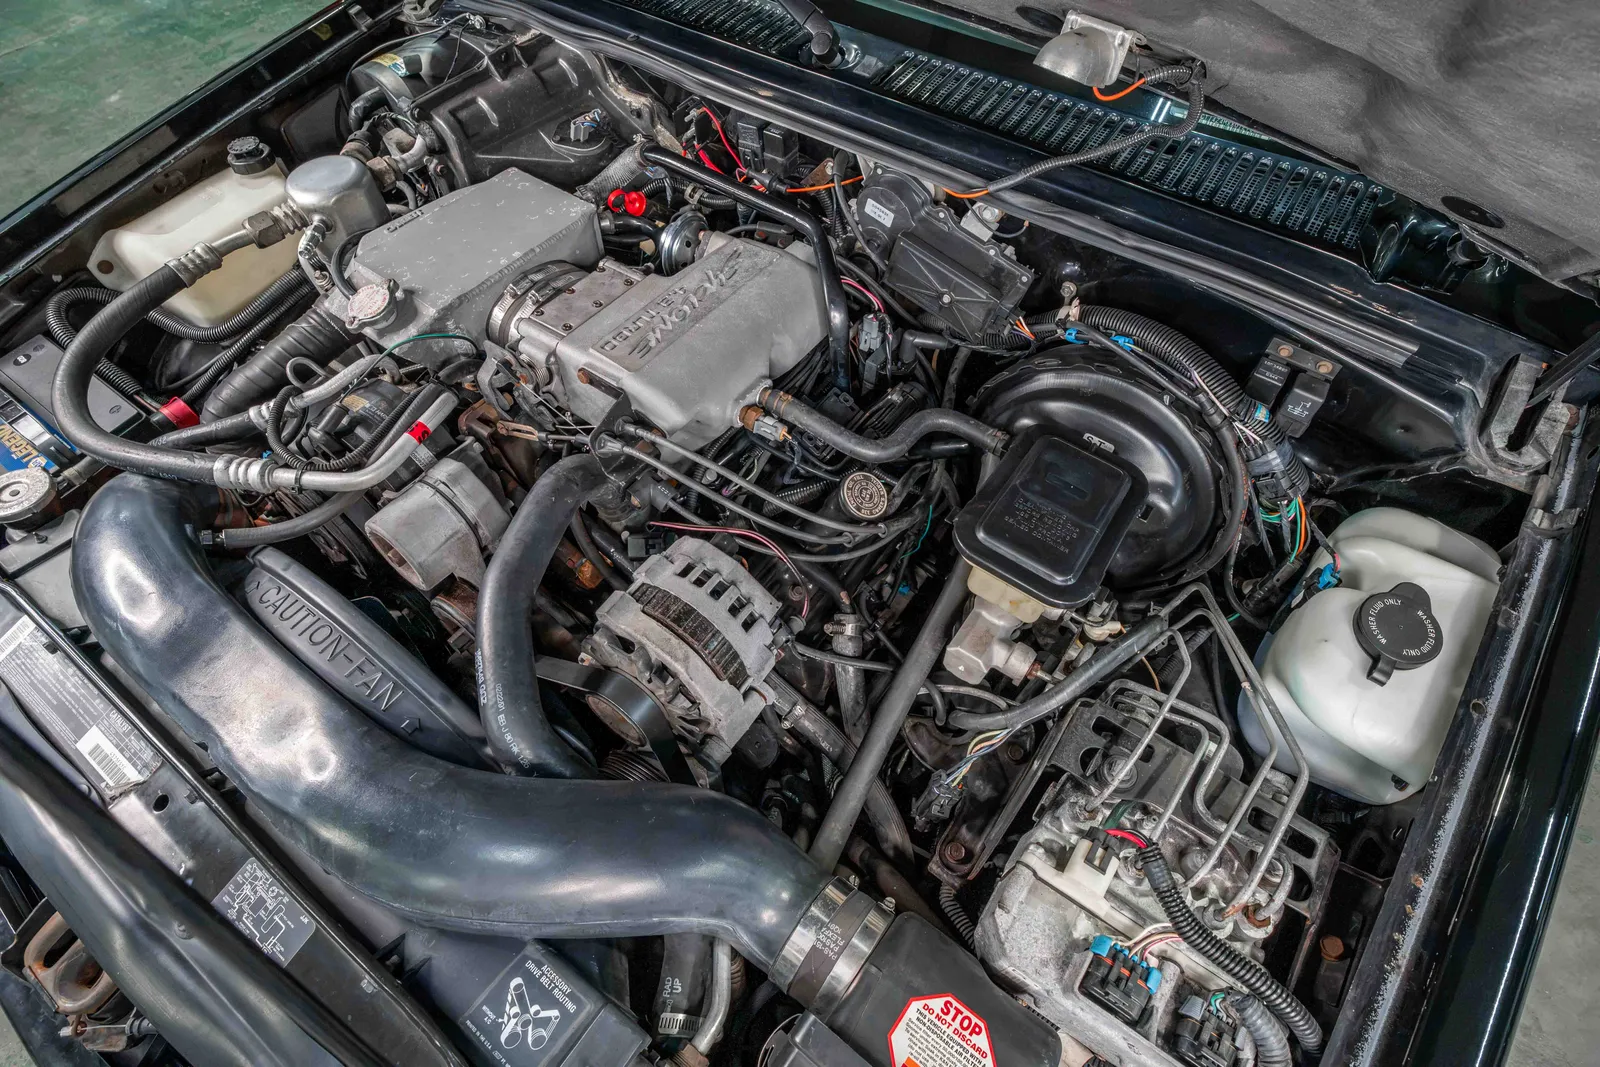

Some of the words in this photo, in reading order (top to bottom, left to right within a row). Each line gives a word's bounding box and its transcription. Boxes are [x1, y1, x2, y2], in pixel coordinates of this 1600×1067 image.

[658, 284, 686, 308] 4.3
[600, 310, 660, 351] TURBO
[1370, 601, 1384, 616] FLUID
[1368, 616, 1387, 644] WASHER
[1417, 610, 1435, 638] WASHER
[1420, 637, 1434, 653] FLUID
[109, 708, 132, 732] CATALYST
[525, 960, 542, 978] DRIVE
[540, 975, 554, 990] BELT
[552, 988, 577, 1013] ROUTING
[540, 965, 572, 995] ACCESSORY
[663, 977, 672, 997] RAD
[672, 978, 682, 993] UP
[922, 1003, 935, 1015] DO
[935, 1013, 952, 1029] NOT
[952, 1028, 988, 1059] DISCARD
[940, 1000, 983, 1037] STOP
[916, 1008, 927, 1019] THIS
[927, 1016, 947, 1035] VEHICLE
[946, 1033, 970, 1055] EQUIPPED
[970, 1052, 982, 1064] WITH
[916, 1016, 954, 1050] NON-DISPOSABLE
[954, 1049, 963, 1057] AIR
